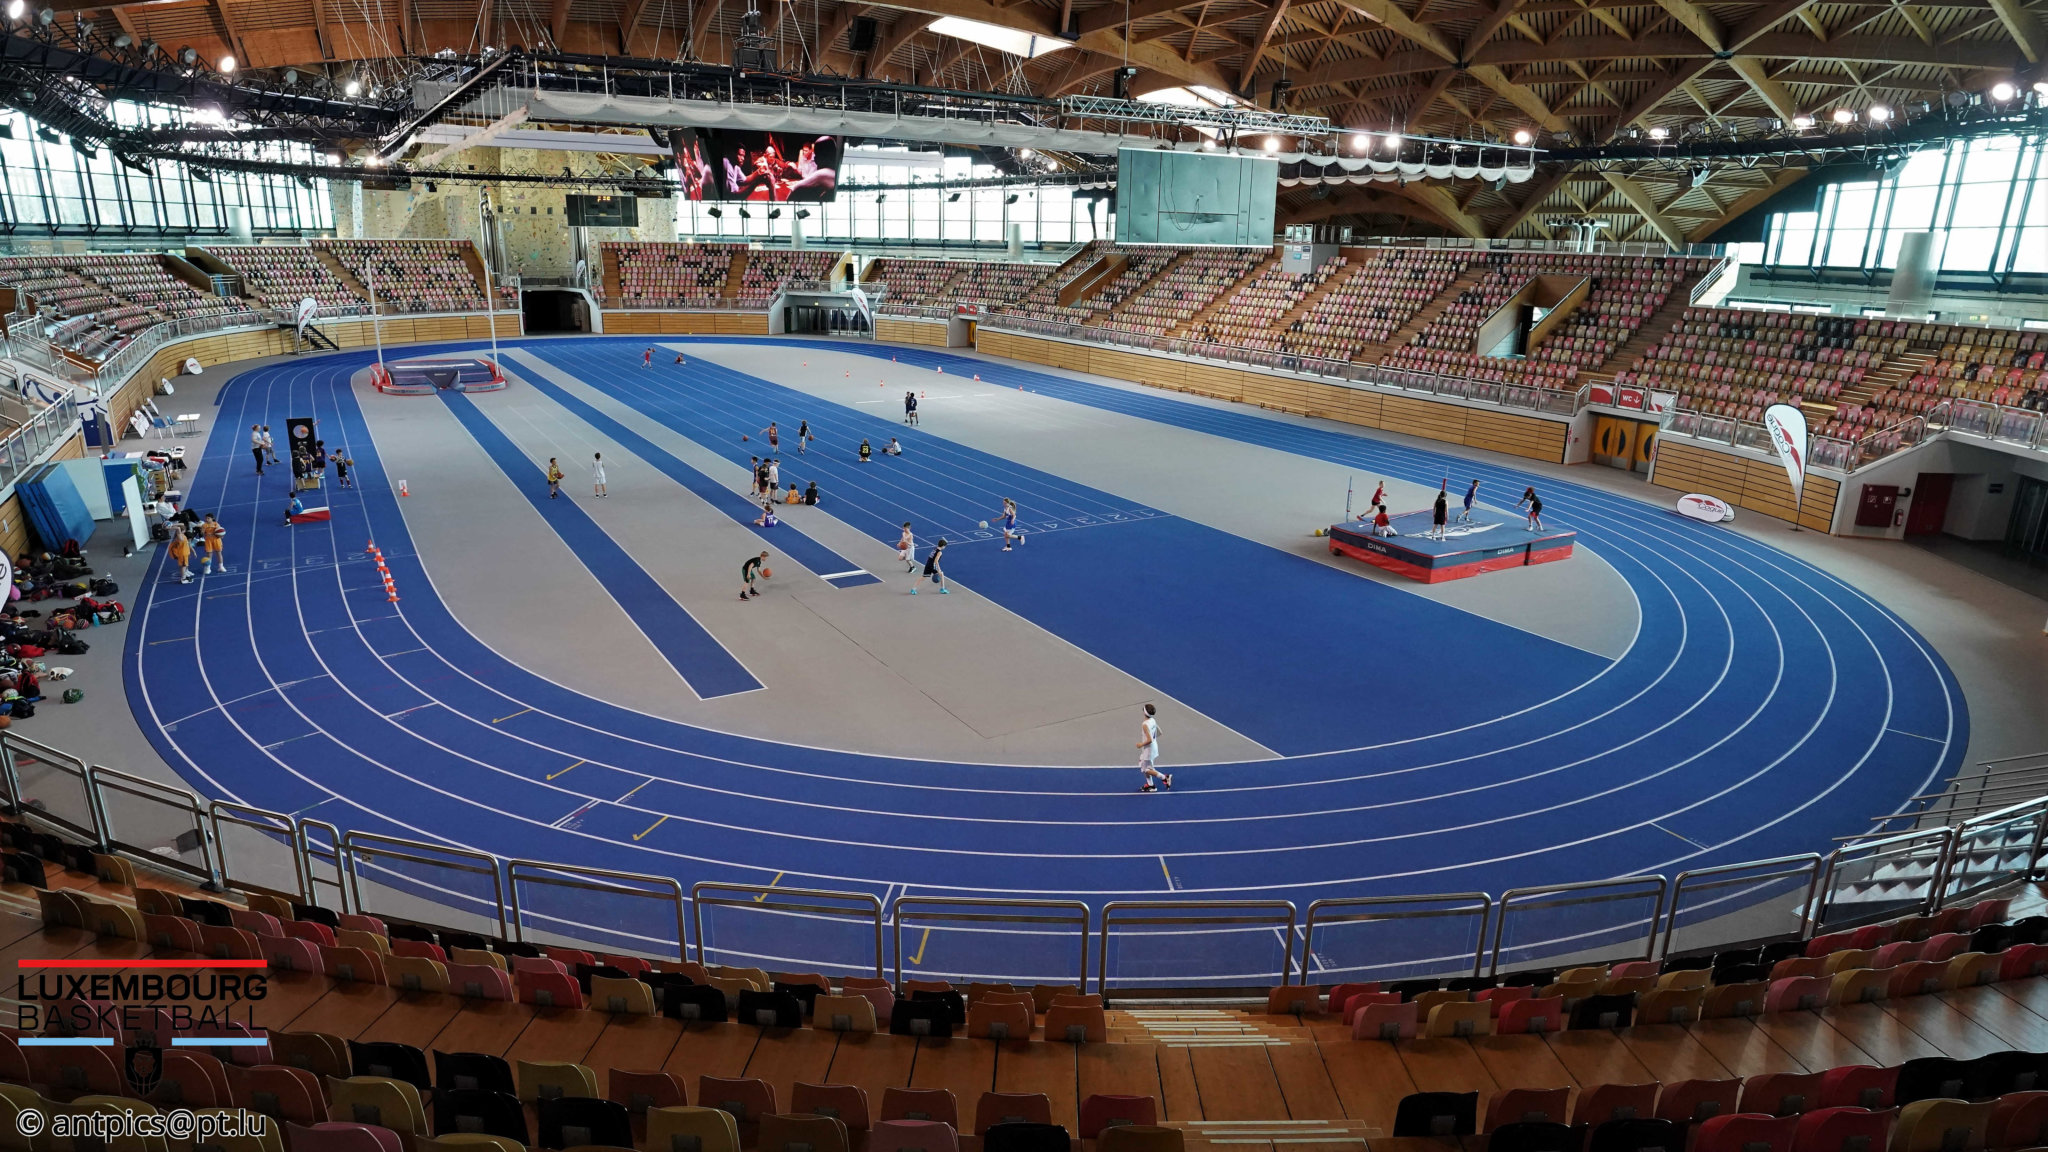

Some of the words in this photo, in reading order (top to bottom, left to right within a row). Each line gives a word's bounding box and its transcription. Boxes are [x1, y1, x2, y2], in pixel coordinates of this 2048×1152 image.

[1622, 394, 1633, 402] WC
[1367, 542, 1387, 553] DIMA
[1497, 547, 1514, 555] DIMA
